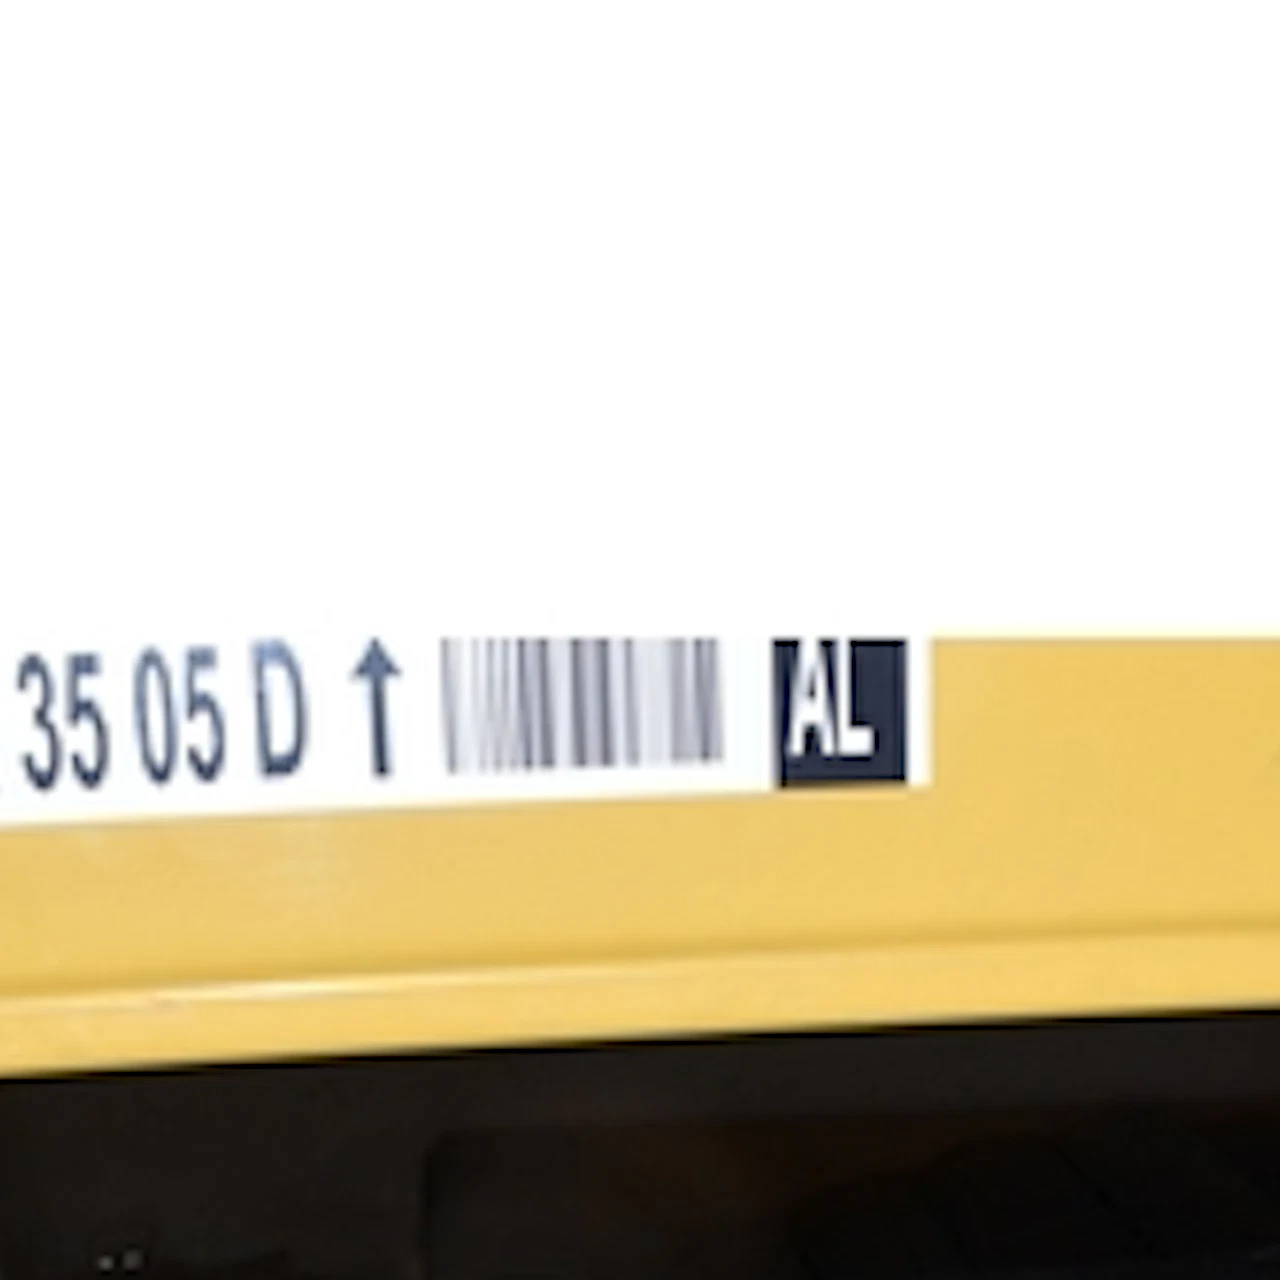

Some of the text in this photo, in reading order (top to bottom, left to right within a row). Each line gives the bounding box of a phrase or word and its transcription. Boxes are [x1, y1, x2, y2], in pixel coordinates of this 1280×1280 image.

[16, 652, 110, 793] 35
[133, 645, 226, 786] 05
[251, 639, 310, 777] D
[784, 640, 874, 757] AL
